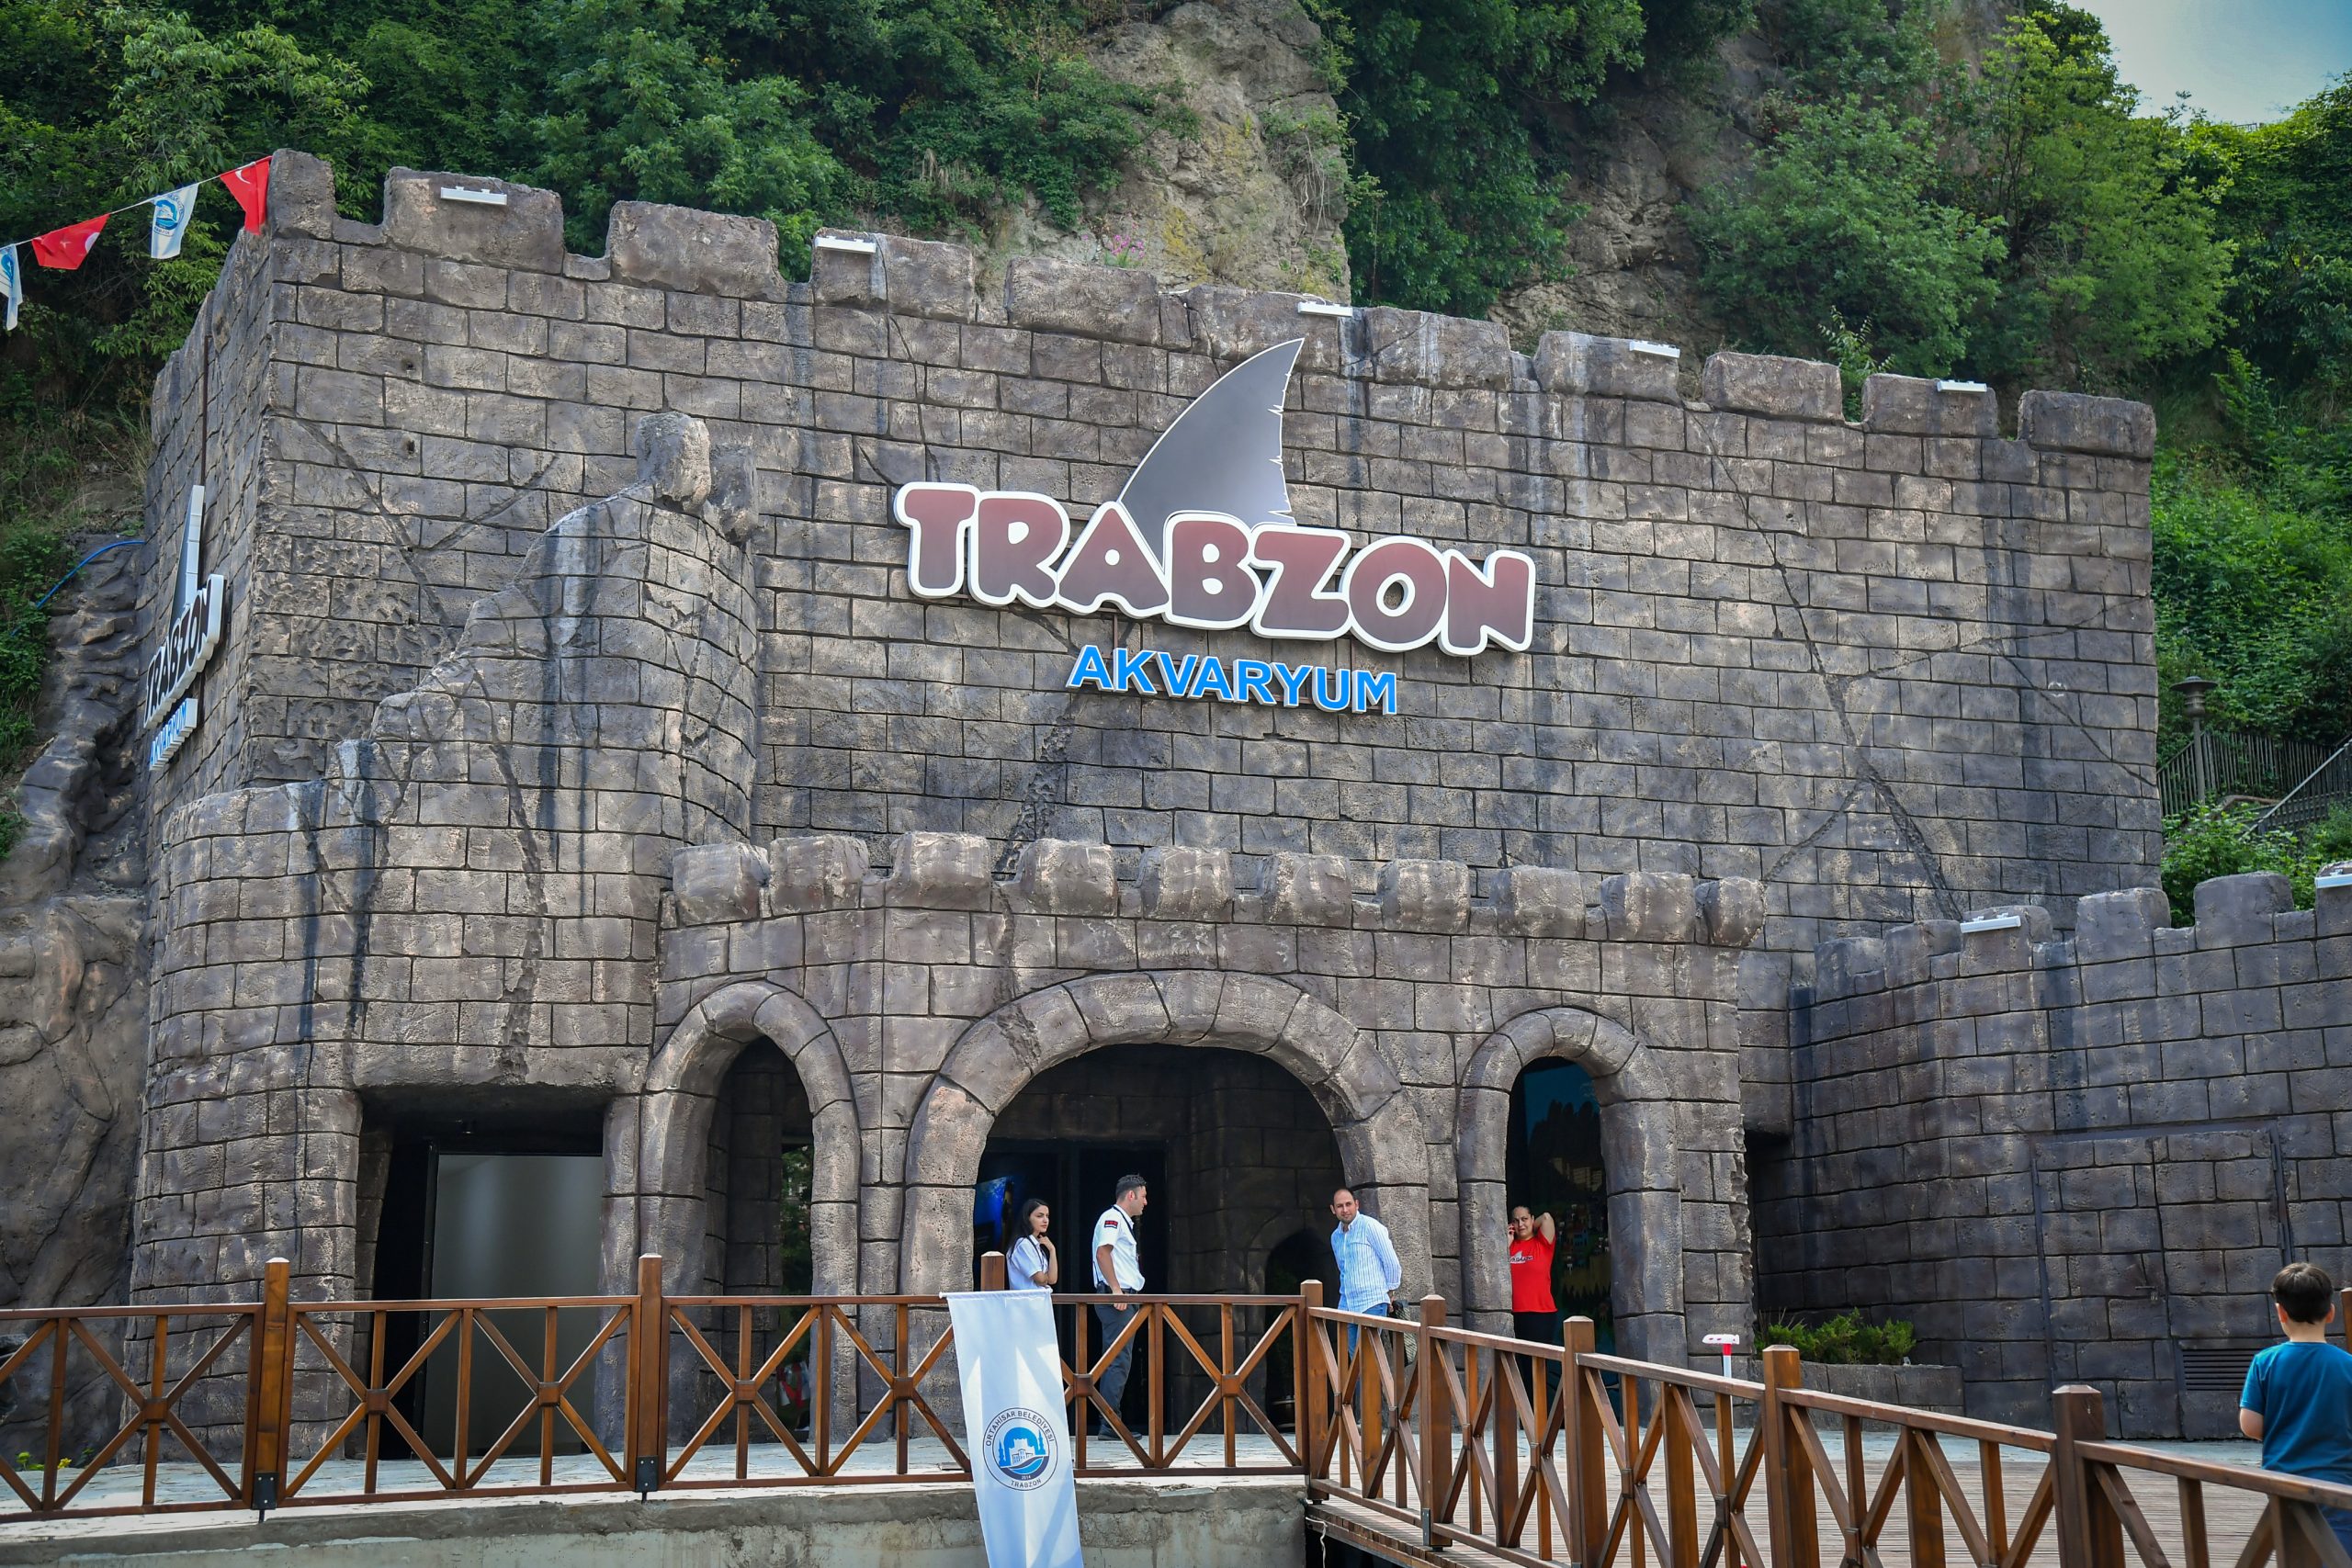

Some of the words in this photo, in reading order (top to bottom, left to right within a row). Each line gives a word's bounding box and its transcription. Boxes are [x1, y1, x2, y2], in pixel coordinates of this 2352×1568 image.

[894, 481, 1535, 656] TRABZON
[143, 574, 221, 728] TRABZON
[1066, 644, 1397, 716] AKVARYUM
[1017, 1410, 1055, 1442] BELEDİYESİ
[1011, 1478, 1042, 1488] TRABZON
